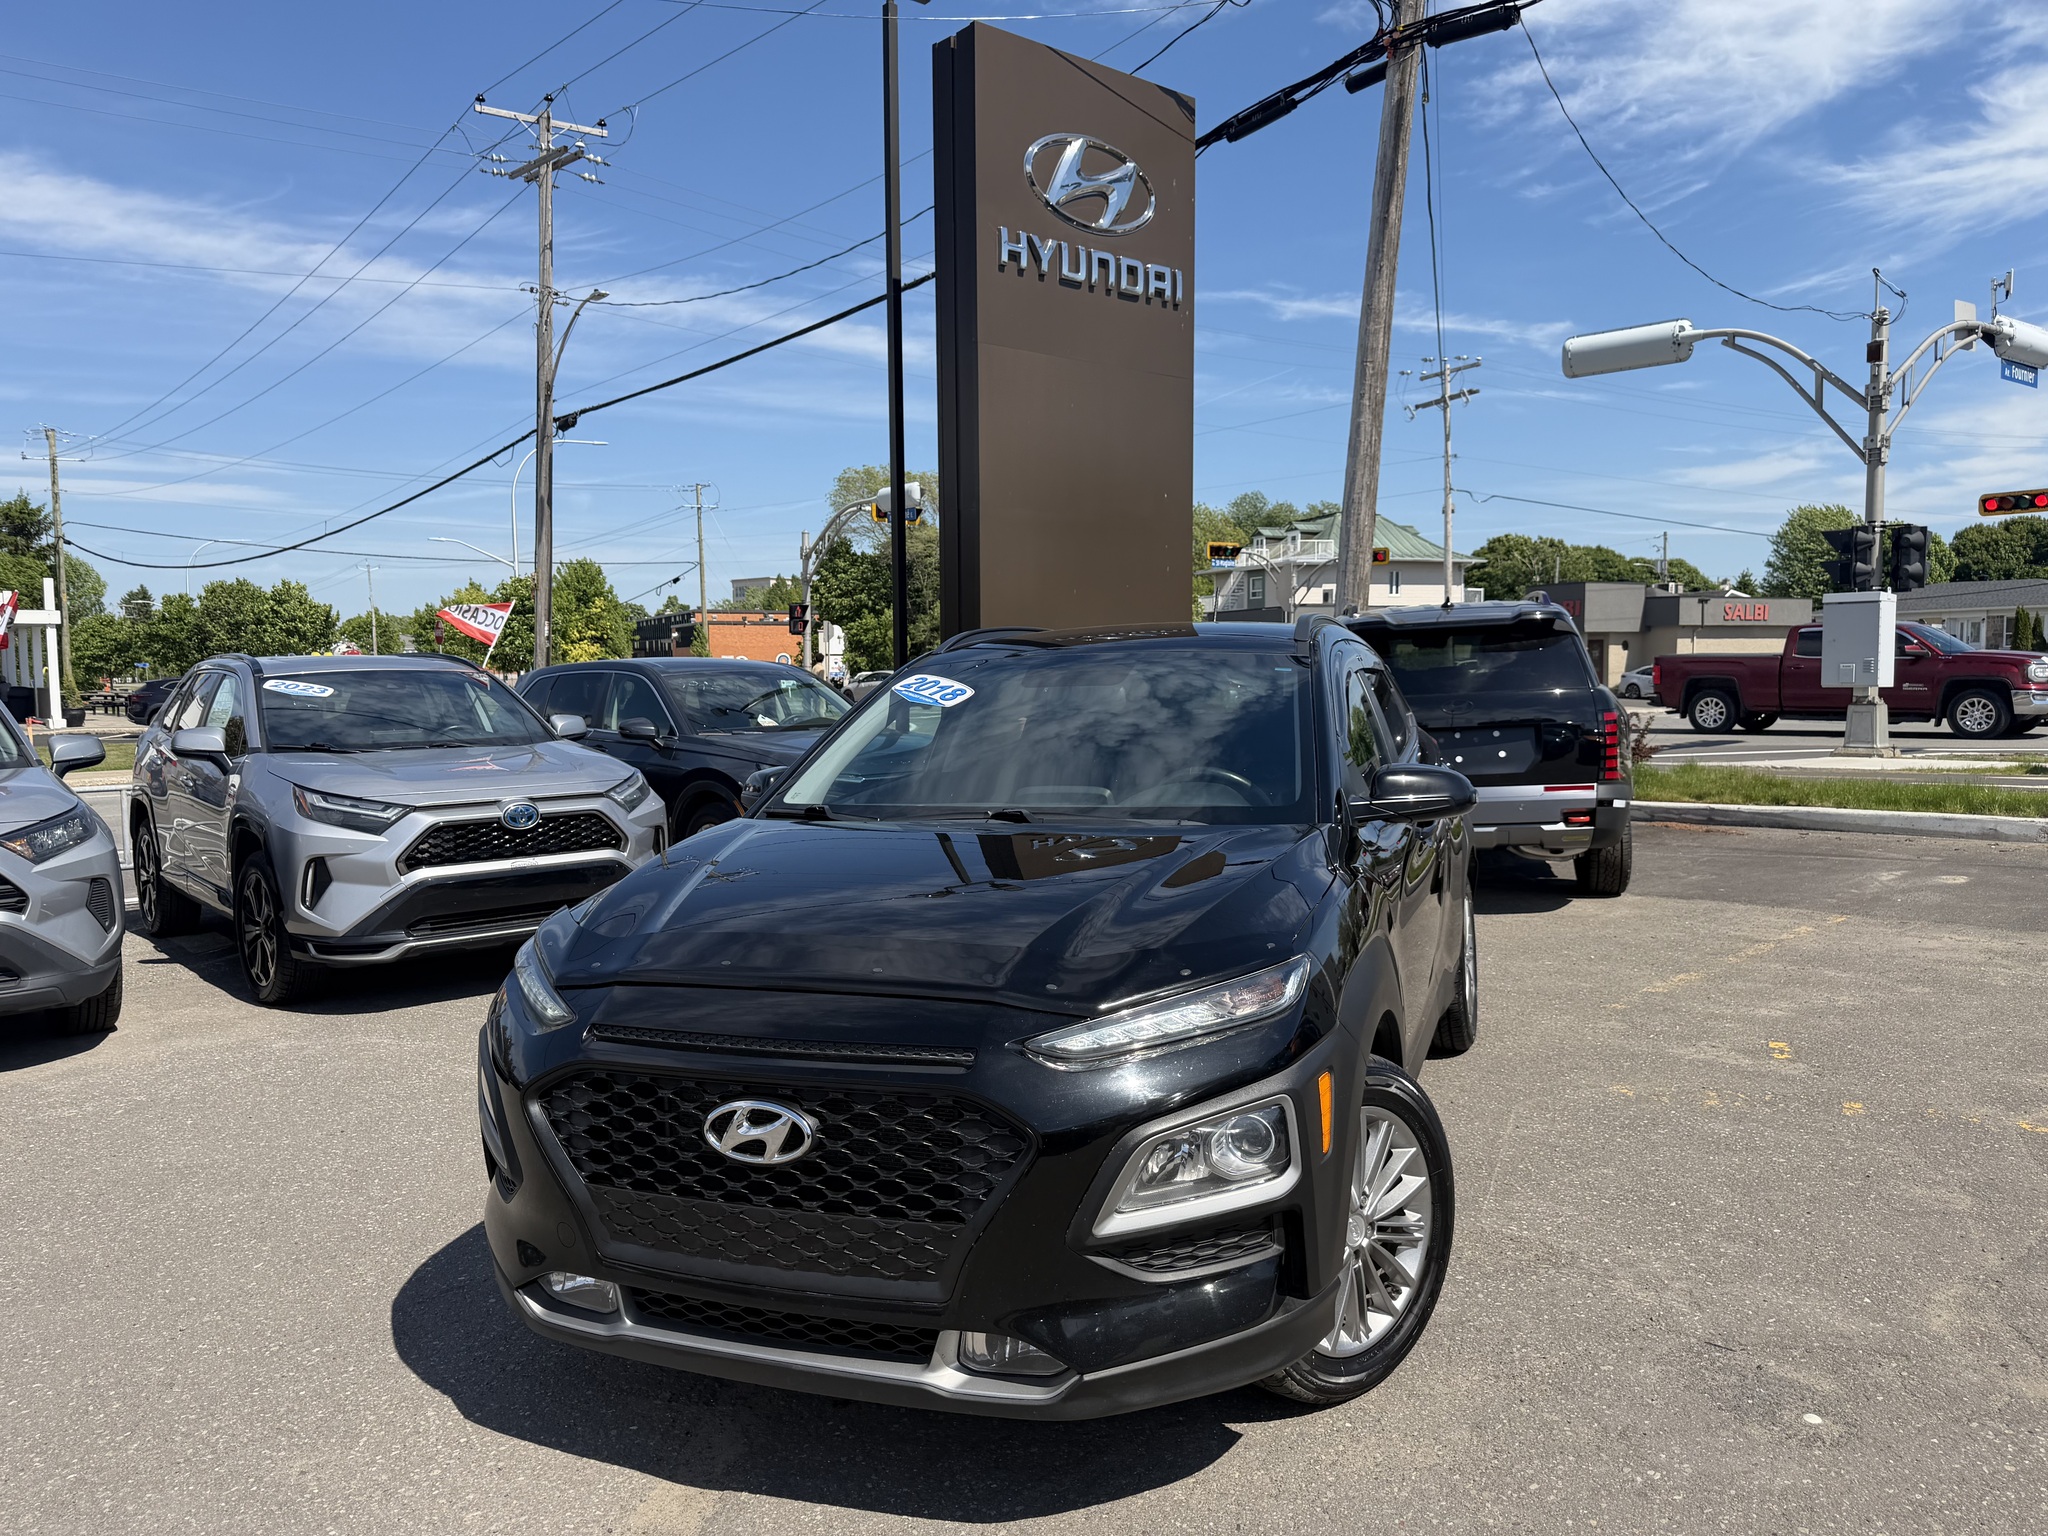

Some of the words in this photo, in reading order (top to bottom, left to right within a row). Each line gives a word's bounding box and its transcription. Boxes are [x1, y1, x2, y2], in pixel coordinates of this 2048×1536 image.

[998, 226, 1183, 304] HYUNDAI
[2011, 365, 2035, 384] Fournier
[1724, 603, 1770, 622] SALBI
[268, 682, 329, 694] 2023
[900, 677, 967, 701] 2018
